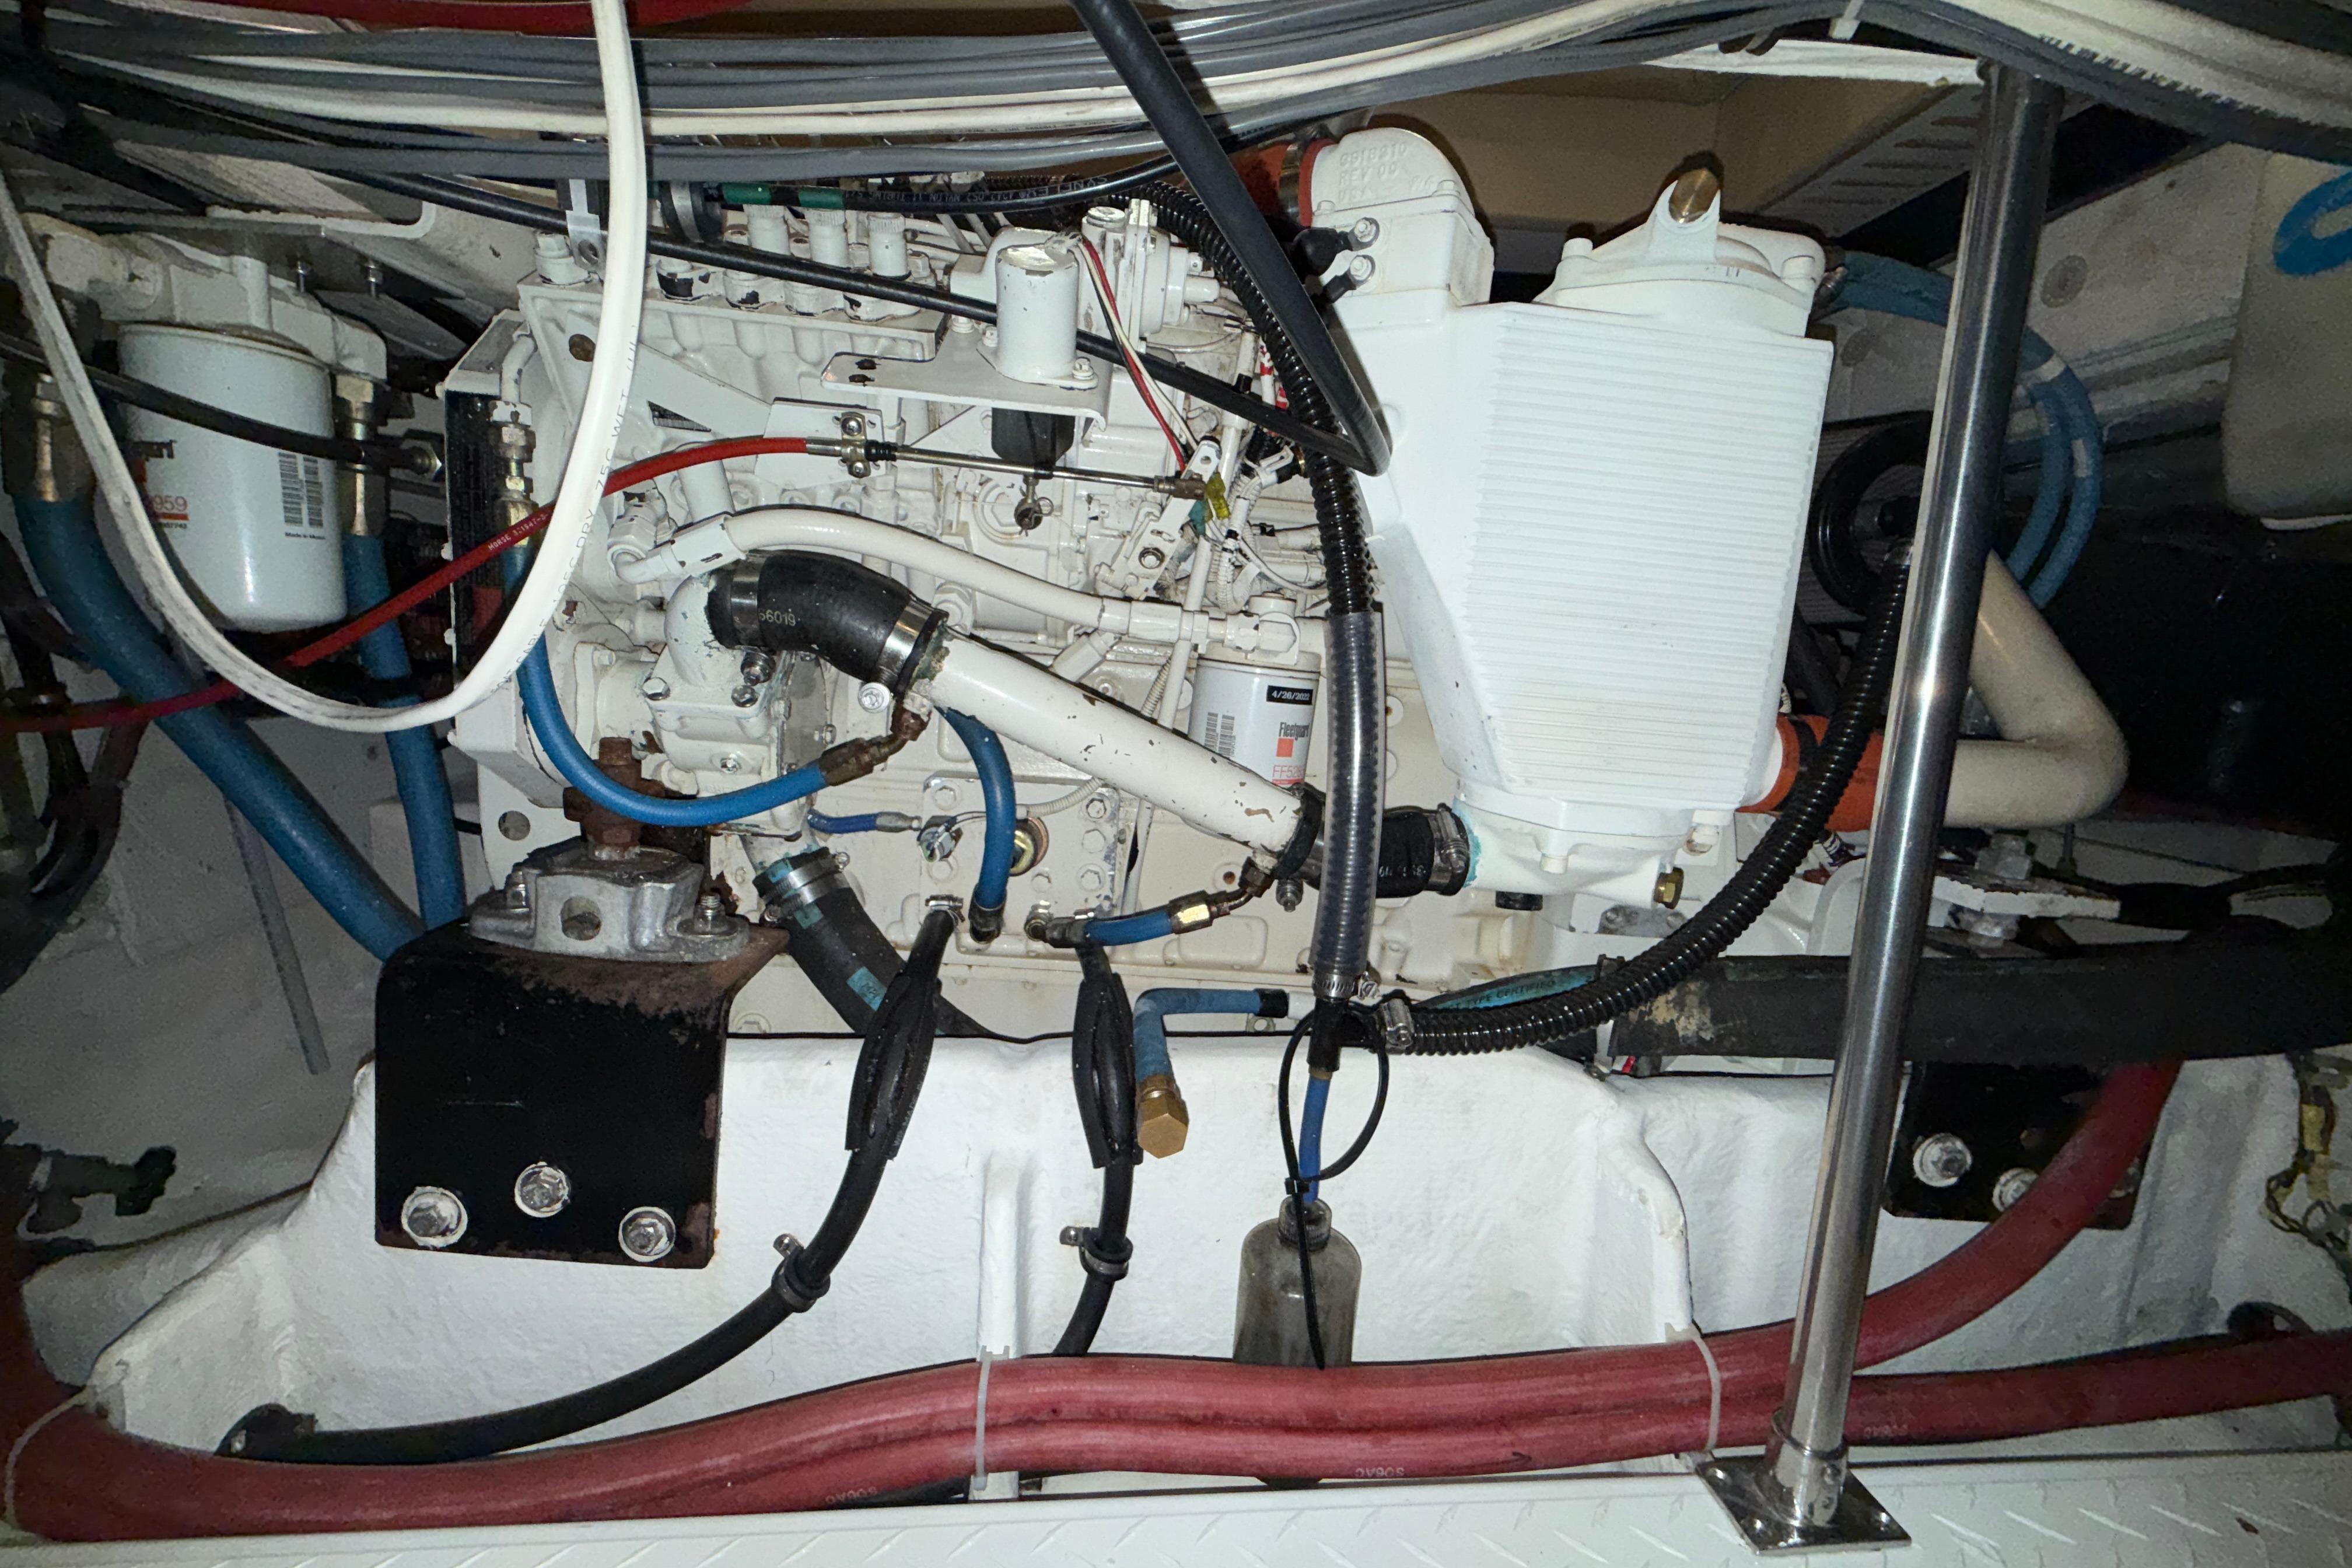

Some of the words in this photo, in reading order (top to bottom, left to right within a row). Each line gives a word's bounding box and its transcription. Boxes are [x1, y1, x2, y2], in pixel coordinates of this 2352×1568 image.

[576, 509, 594, 548] DRY
[488, 534, 512, 551] MORSE
[1271, 690, 1310, 701] 4/26/2022
